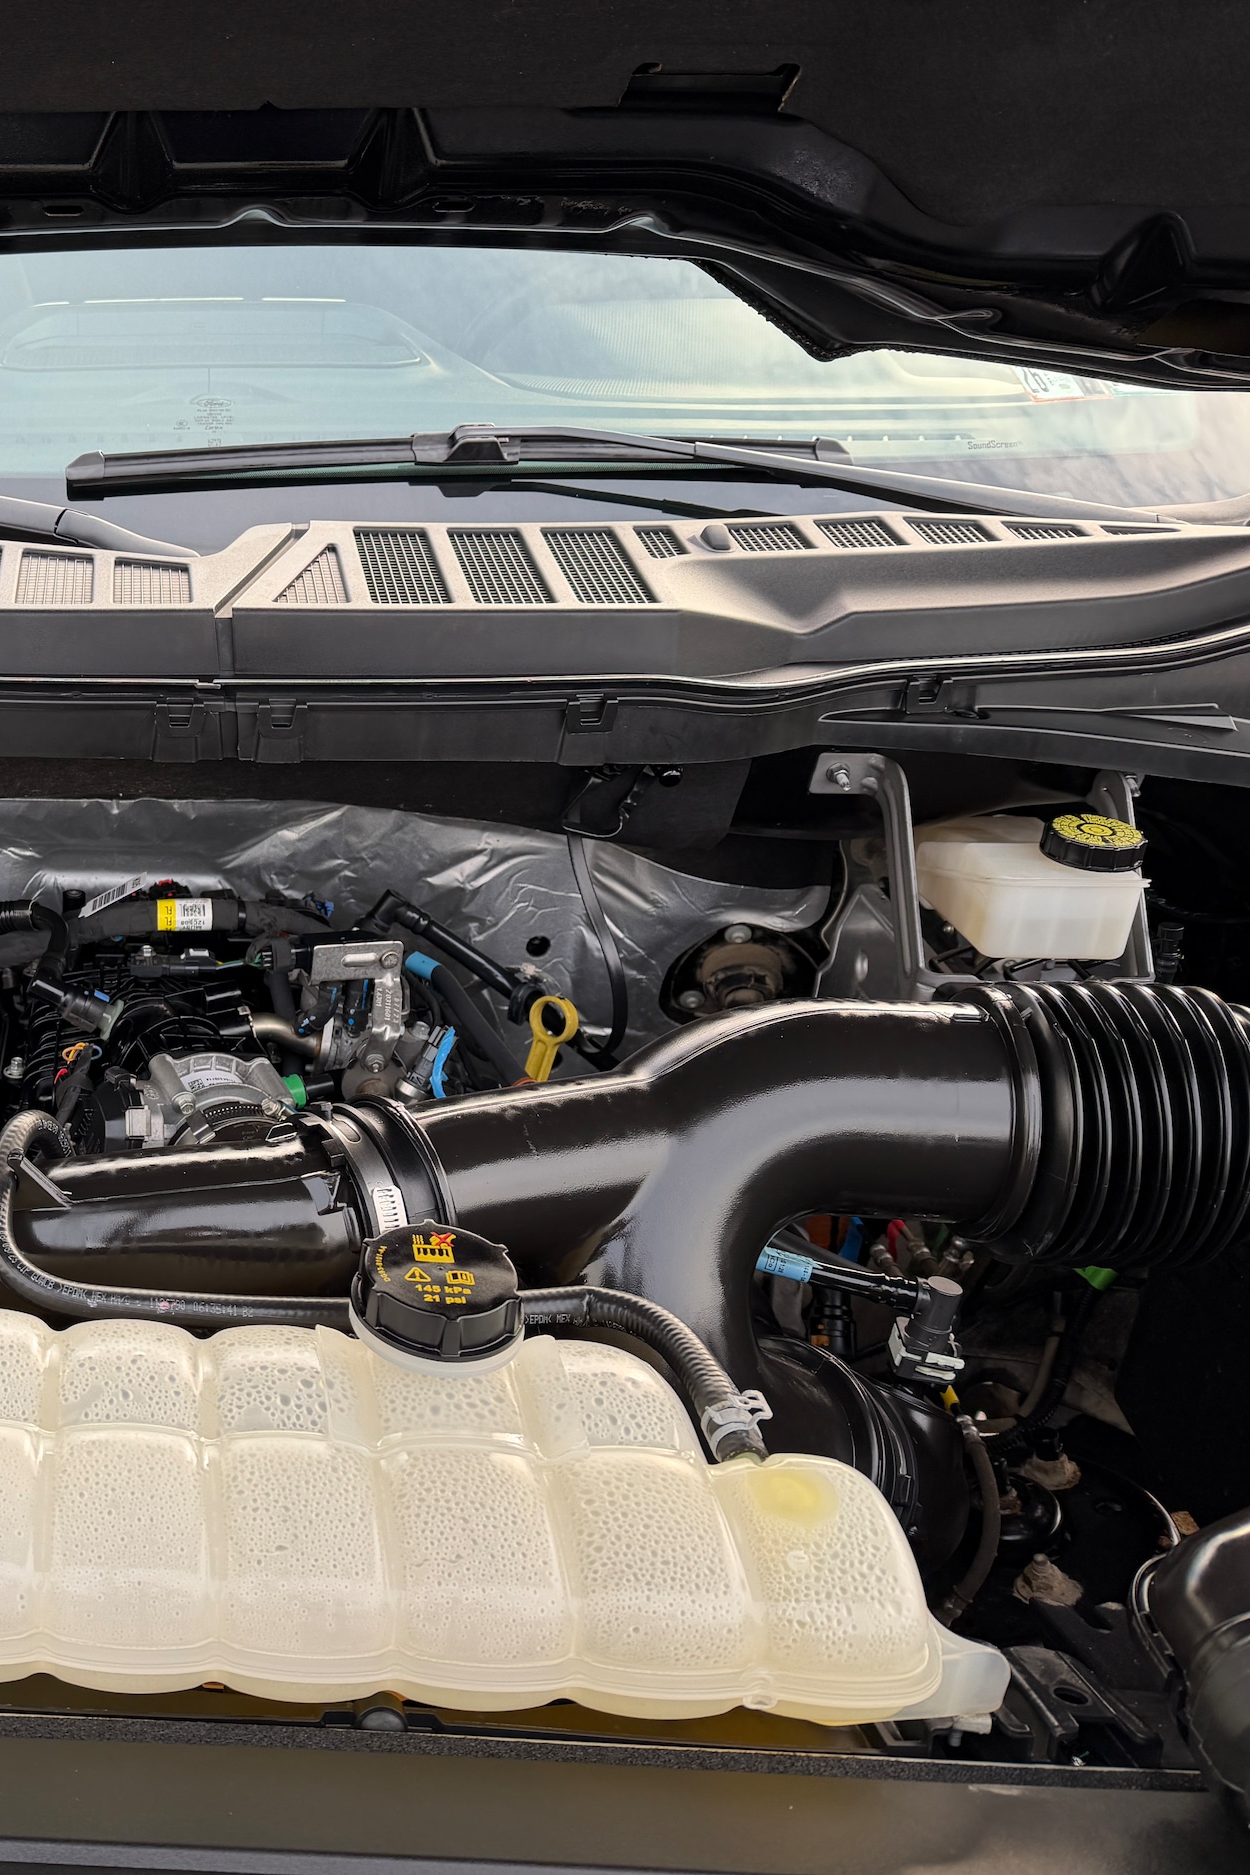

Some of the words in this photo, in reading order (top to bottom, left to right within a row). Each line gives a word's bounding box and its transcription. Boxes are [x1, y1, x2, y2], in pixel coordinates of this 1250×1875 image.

[415, 1284, 441, 1293] 145
[444, 1285, 472, 1295] kPa
[423, 1294, 441, 1303] 21
[445, 1296, 467, 1304] psi
